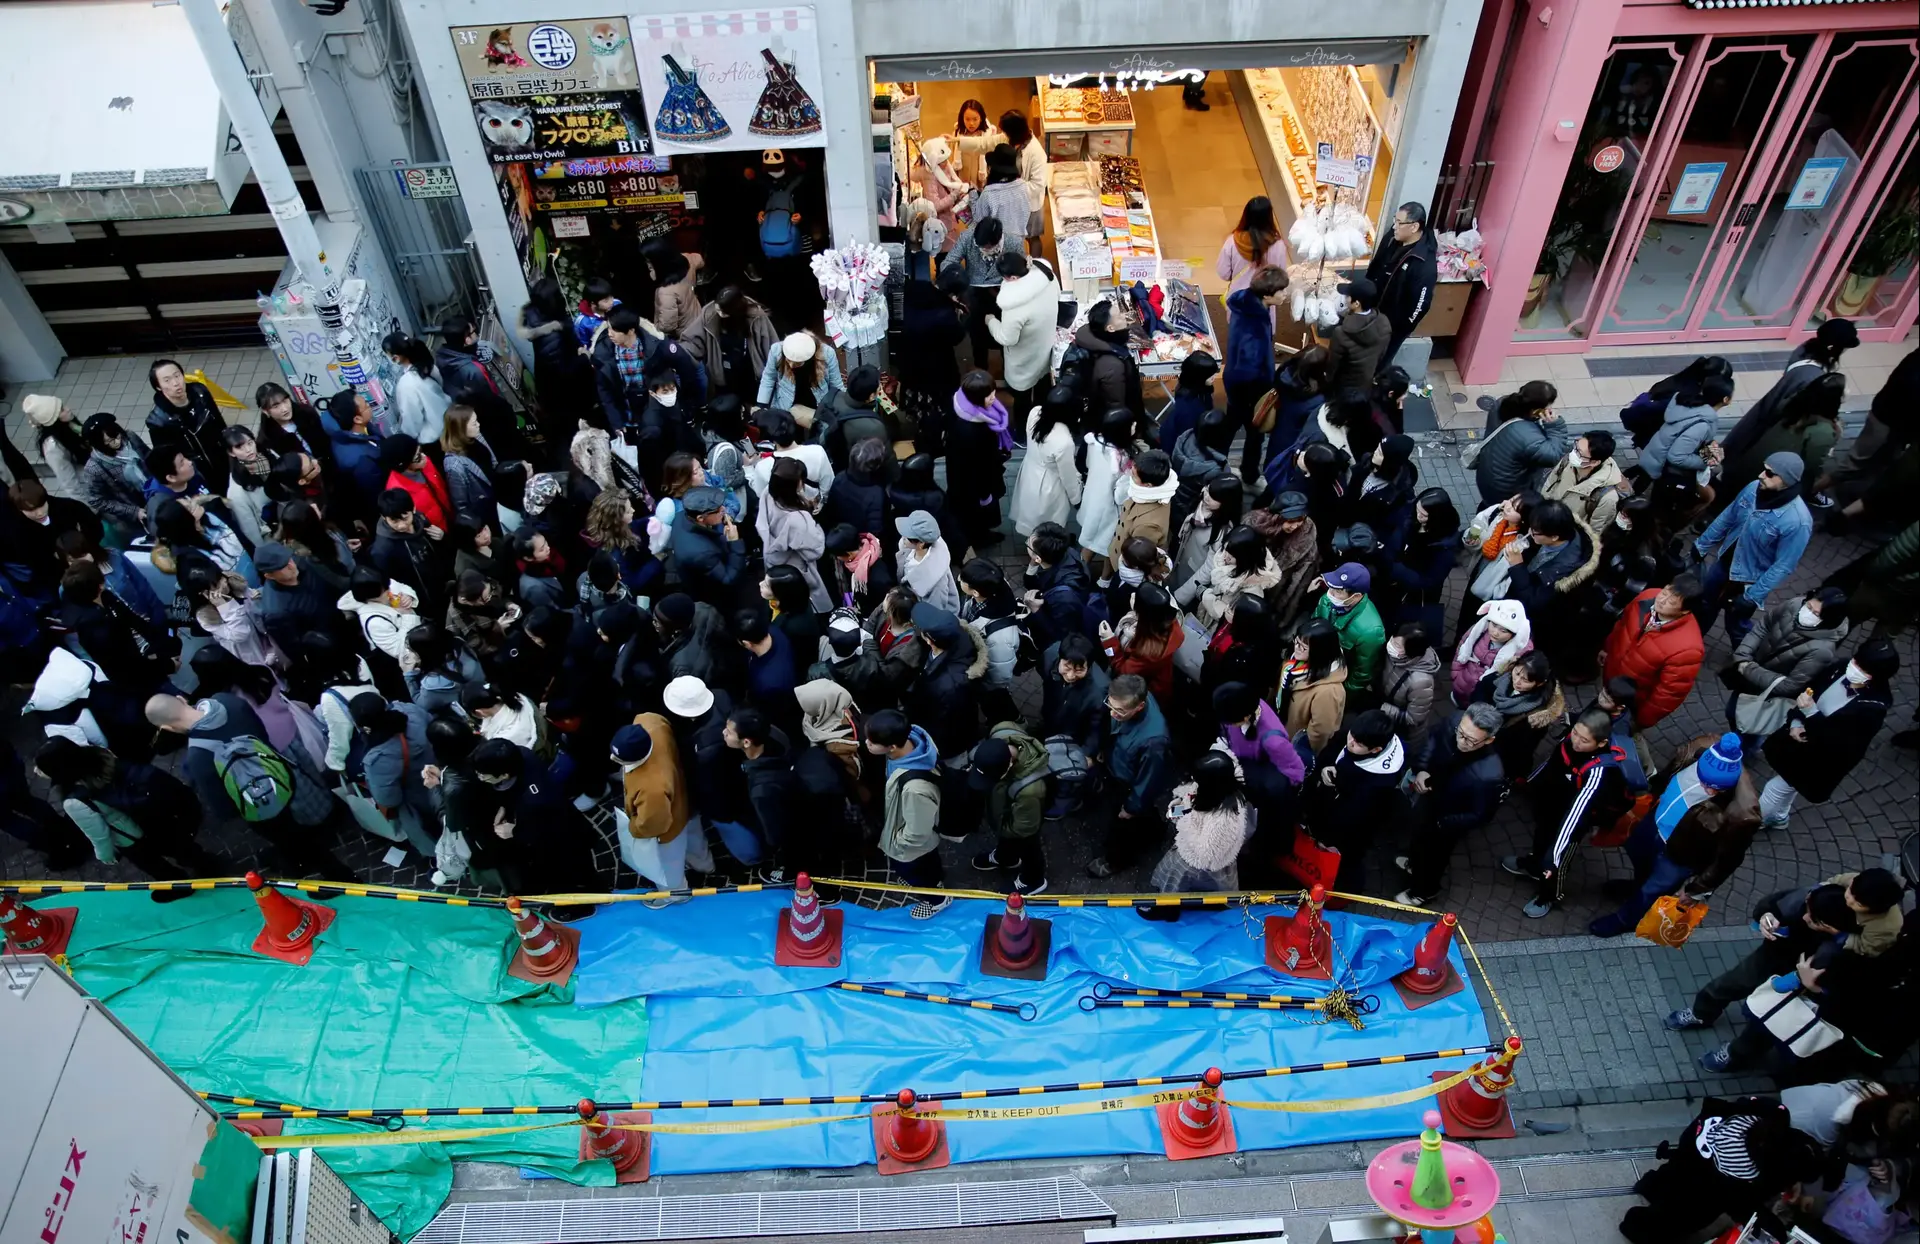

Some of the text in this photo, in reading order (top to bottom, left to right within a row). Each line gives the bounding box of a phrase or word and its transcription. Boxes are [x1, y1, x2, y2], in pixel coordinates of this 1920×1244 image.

[457, 31, 478, 45] 3F
[537, 106, 573, 114] HARAJUKU
[597, 102, 622, 110] FOREST
[541, 127, 627, 144] フクロウの森
[617, 139, 650, 153] B1F
[494, 154, 504, 162] Be
[516, 152, 533, 161] ease
[534, 151, 543, 161] by
[543, 150, 566, 159] Owls!
[1601, 154, 1619, 162] TAX
[428, 176, 452, 184] エリア
[619, 176, 656, 192] ¥880
[1326, 173, 1345, 183] 1200
[568, 180, 606, 195] ¥680
[1153, 1092, 1184, 1104] 立入禁止
[1101, 1100, 1123, 1110] 警視庁
[967, 1105, 1061, 1119] 立入禁止 KEEP OUT
